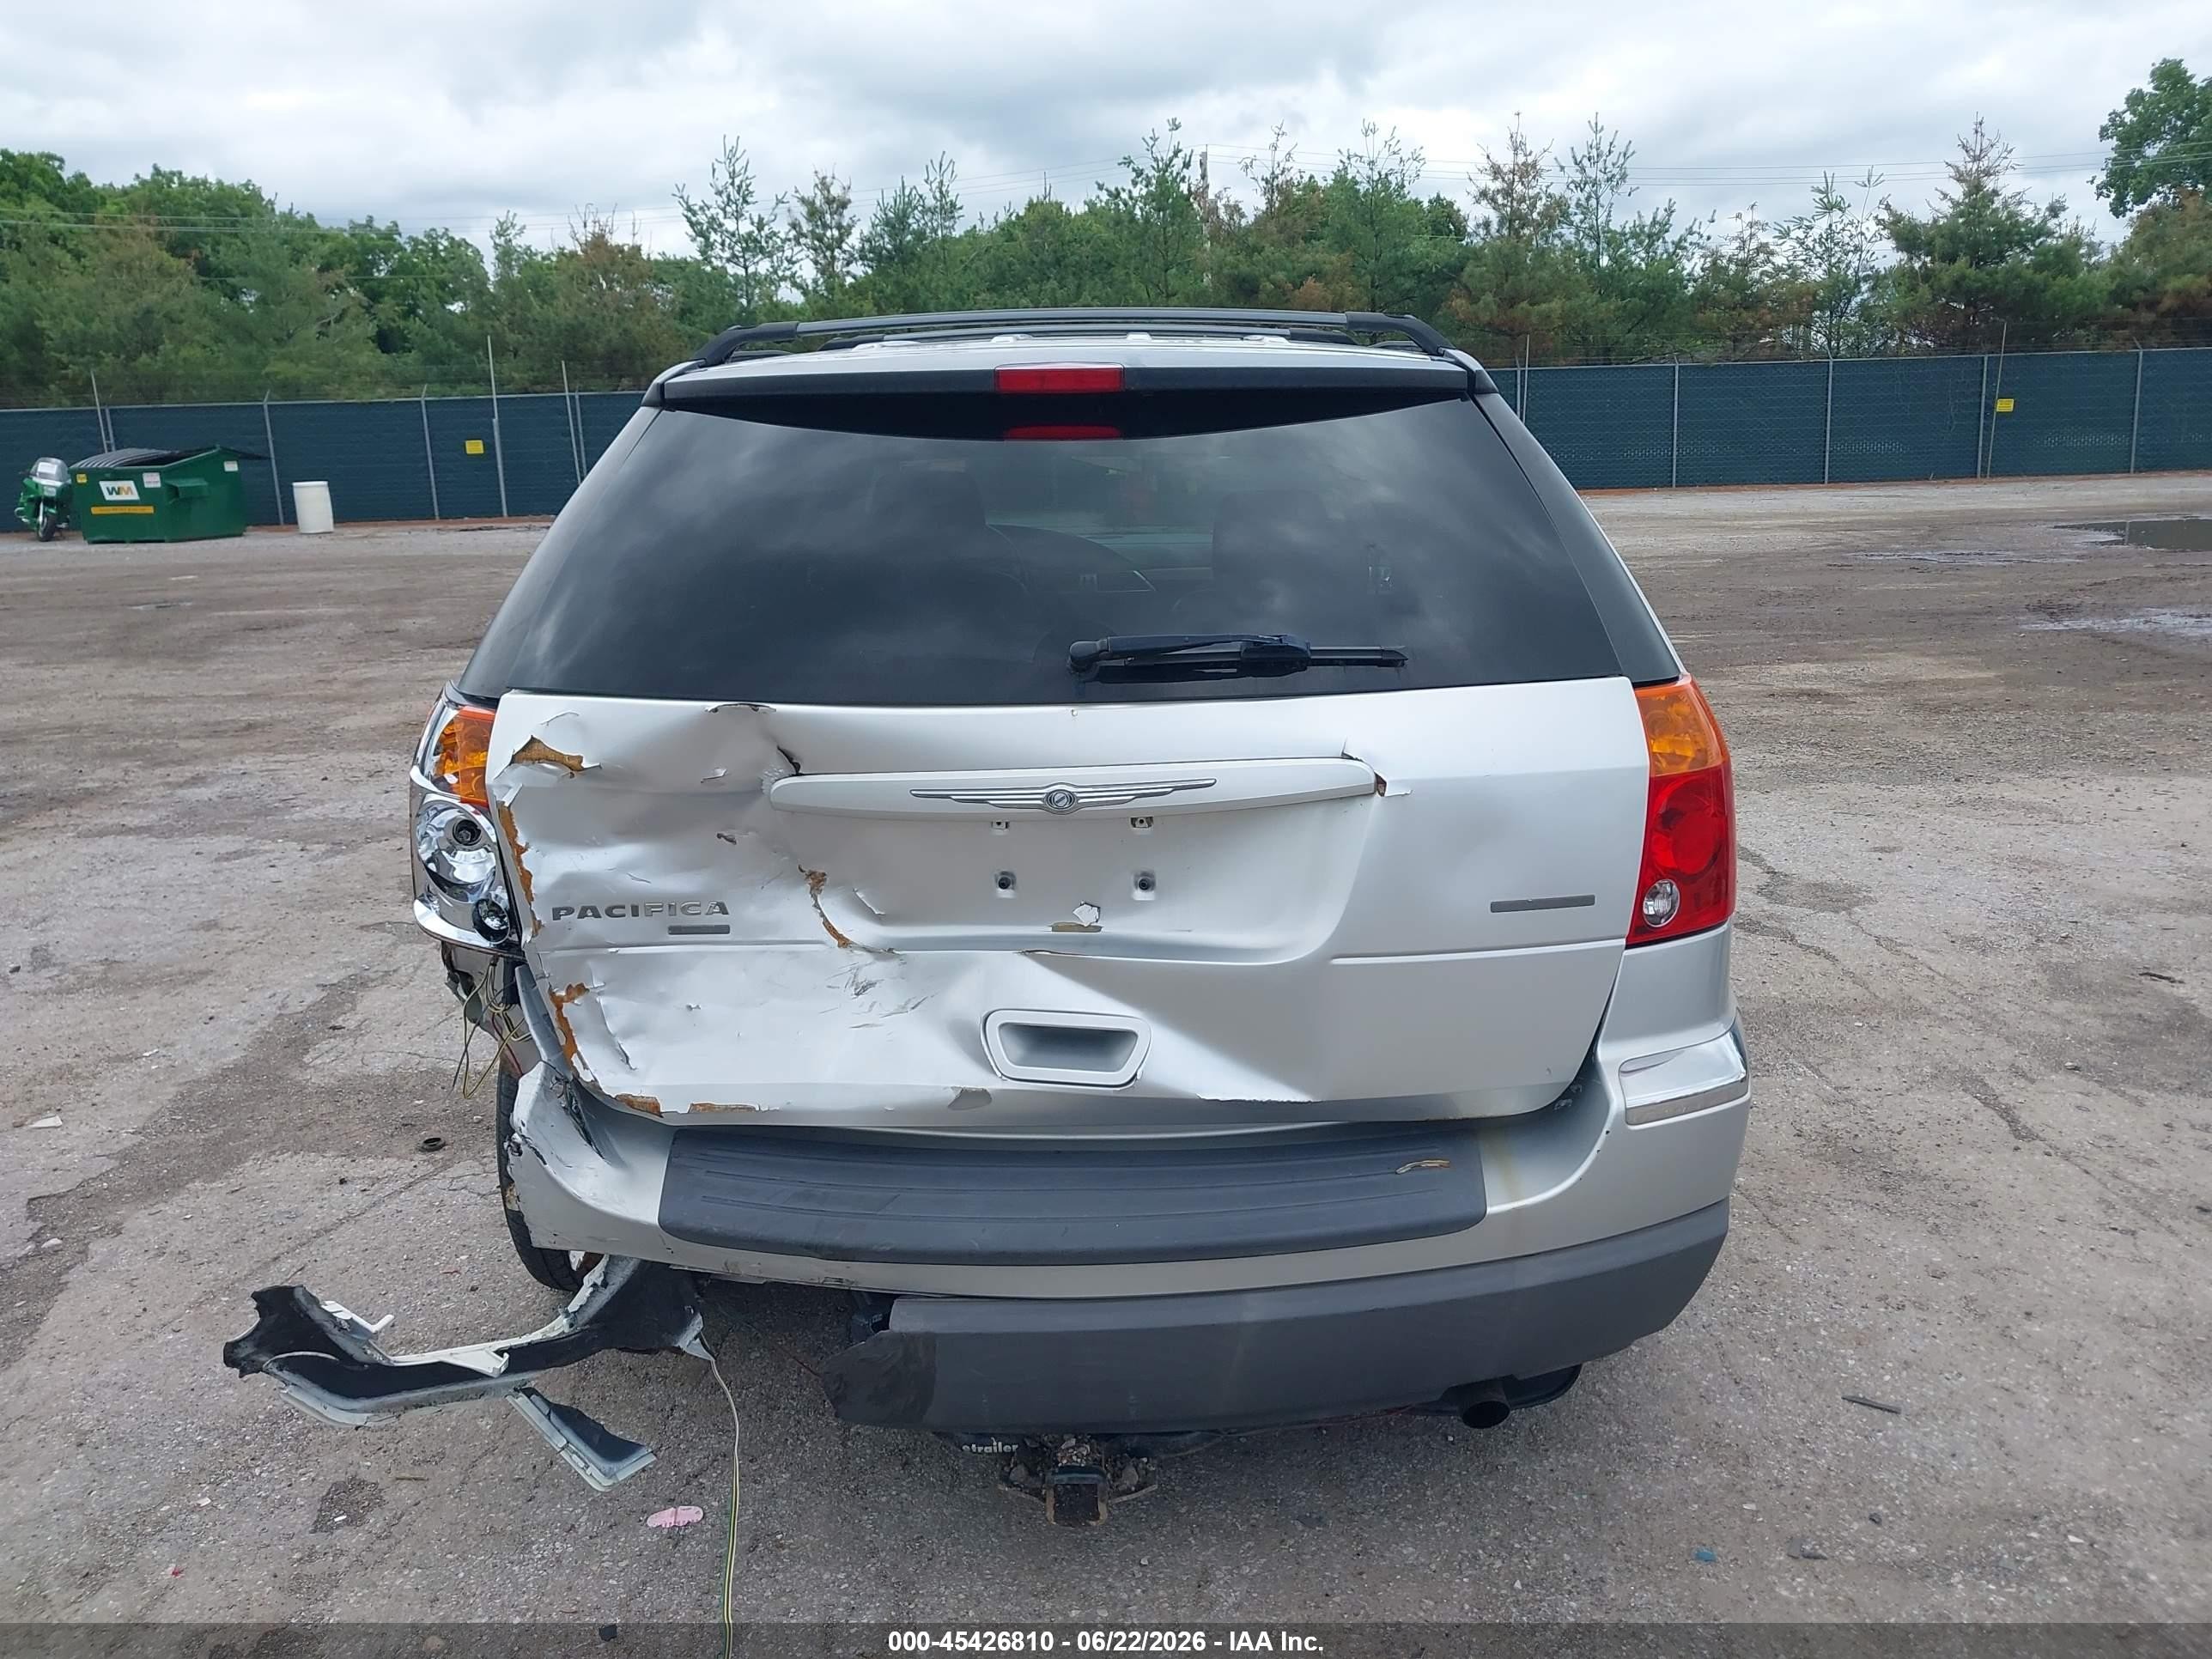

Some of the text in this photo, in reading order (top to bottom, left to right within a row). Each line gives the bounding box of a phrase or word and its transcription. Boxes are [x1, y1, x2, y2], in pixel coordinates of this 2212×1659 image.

[106, 486, 134, 495] WM
[552, 902, 729, 921] PACIFICA
[962, 1437, 1018, 1452] etrailer
